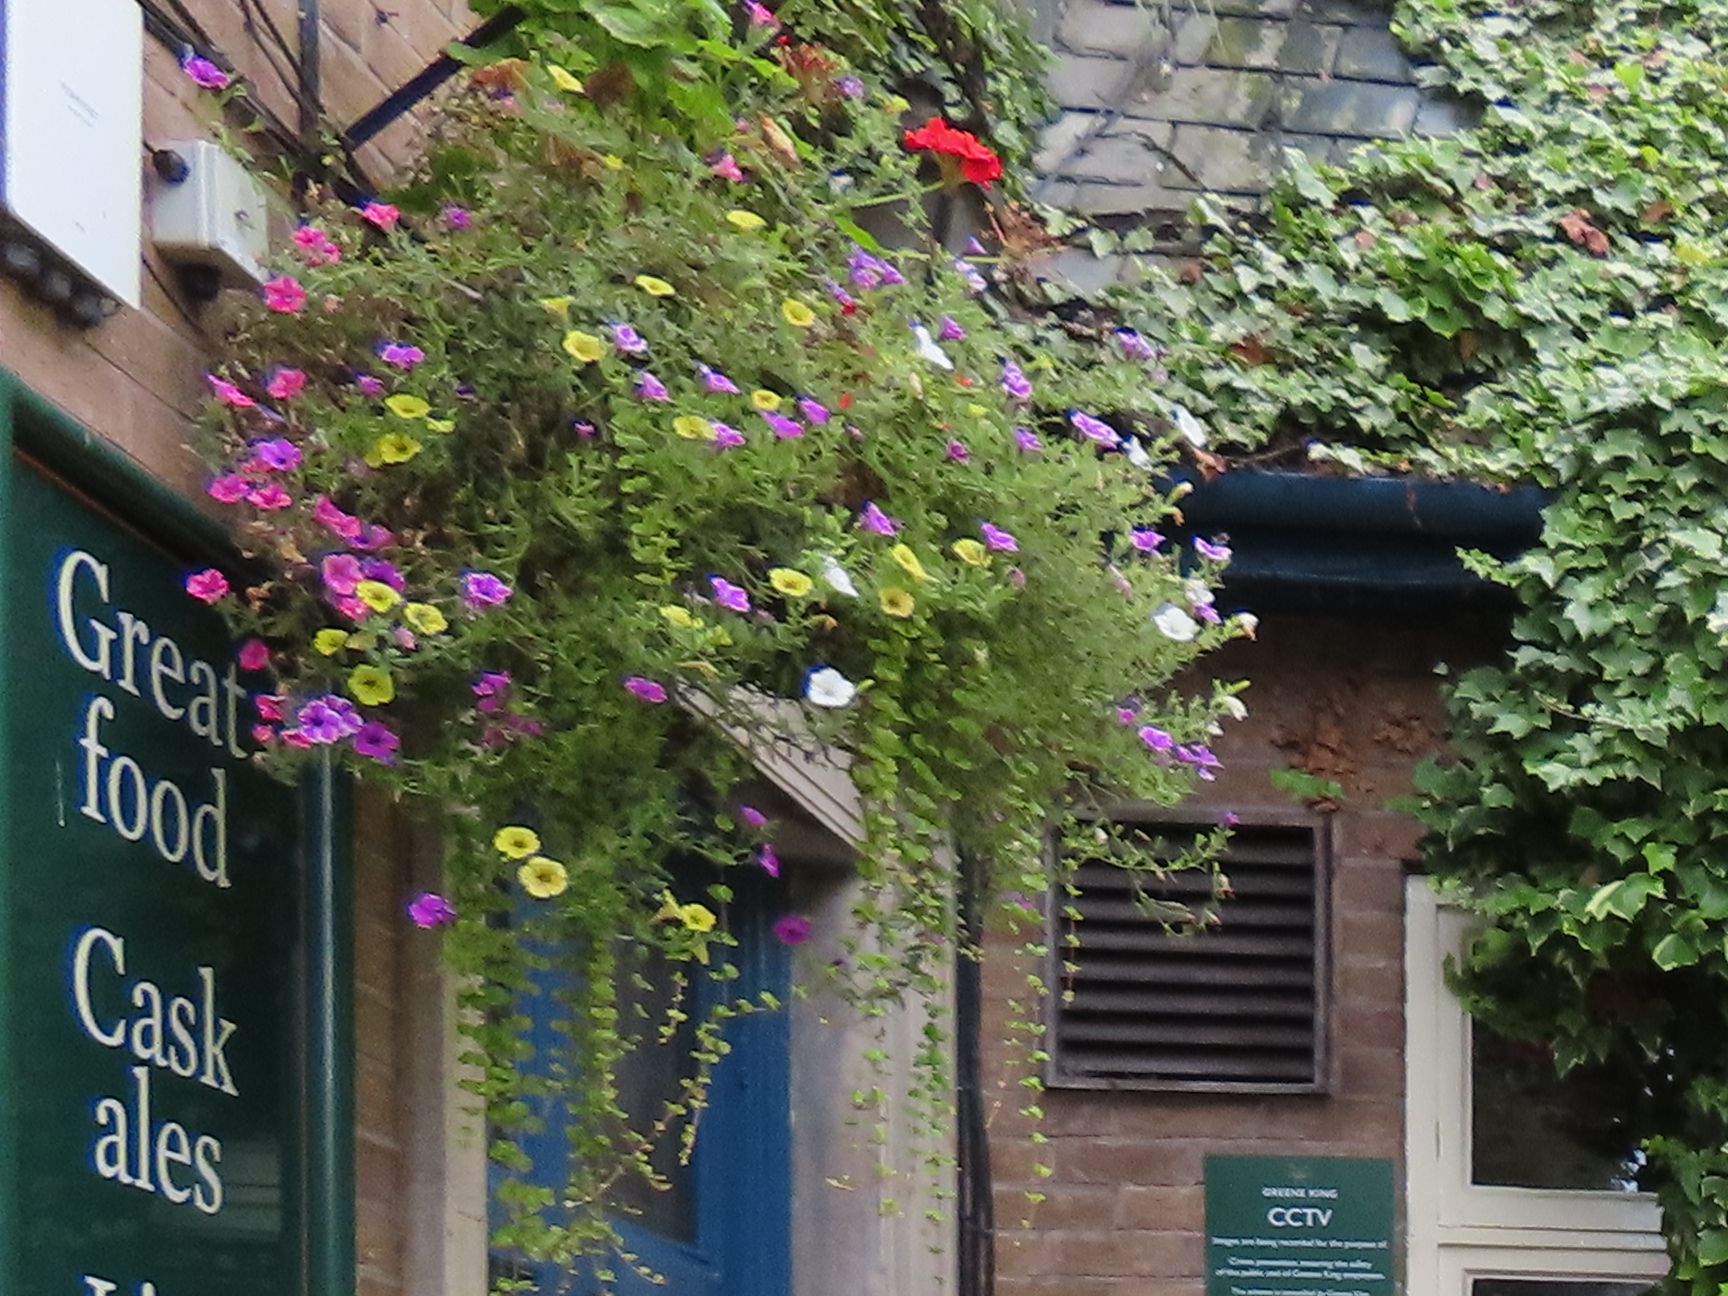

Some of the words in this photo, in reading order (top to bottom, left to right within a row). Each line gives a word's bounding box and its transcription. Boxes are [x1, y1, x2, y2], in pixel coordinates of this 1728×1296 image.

[58, 550, 249, 760] Great
[79, 696, 232, 889] food
[73, 927, 239, 1097] Cask
[94, 1065, 224, 1215] ales
[1266, 1206, 1333, 1227] CCTV
